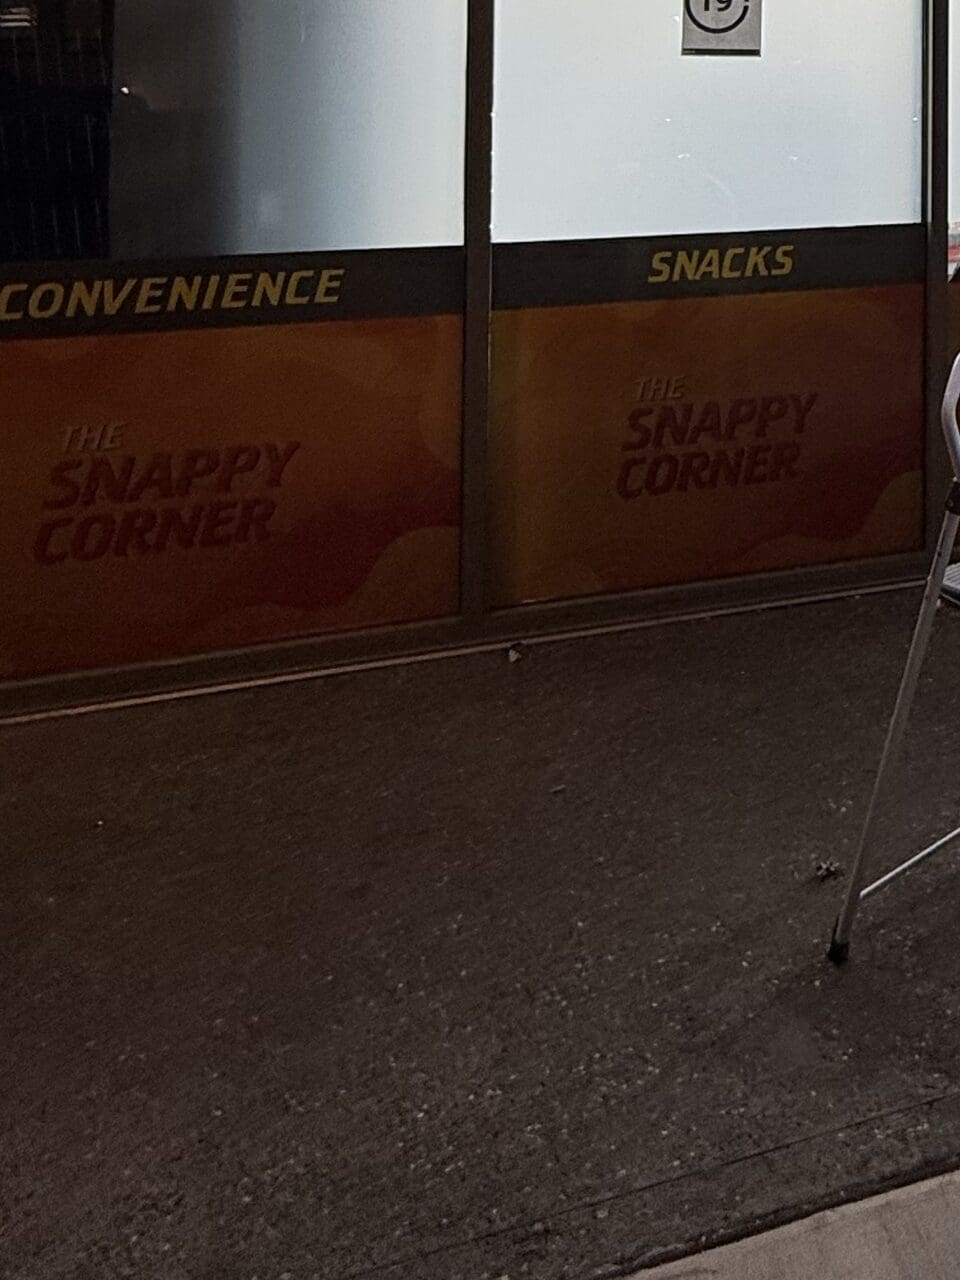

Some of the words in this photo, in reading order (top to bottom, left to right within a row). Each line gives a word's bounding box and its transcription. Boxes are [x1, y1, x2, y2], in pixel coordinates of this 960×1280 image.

[647, 245, 795, 284] SNACKS
[0, 268, 345, 320] CONVENIENCE
[635, 375, 687, 402] THE
[62, 423, 125, 451] THE
[620, 392, 819, 452] SNAPPY
[42, 440, 300, 512] SNAPPY
[616, 441, 805, 500] CORNER
[33, 497, 278, 566] CORNER
